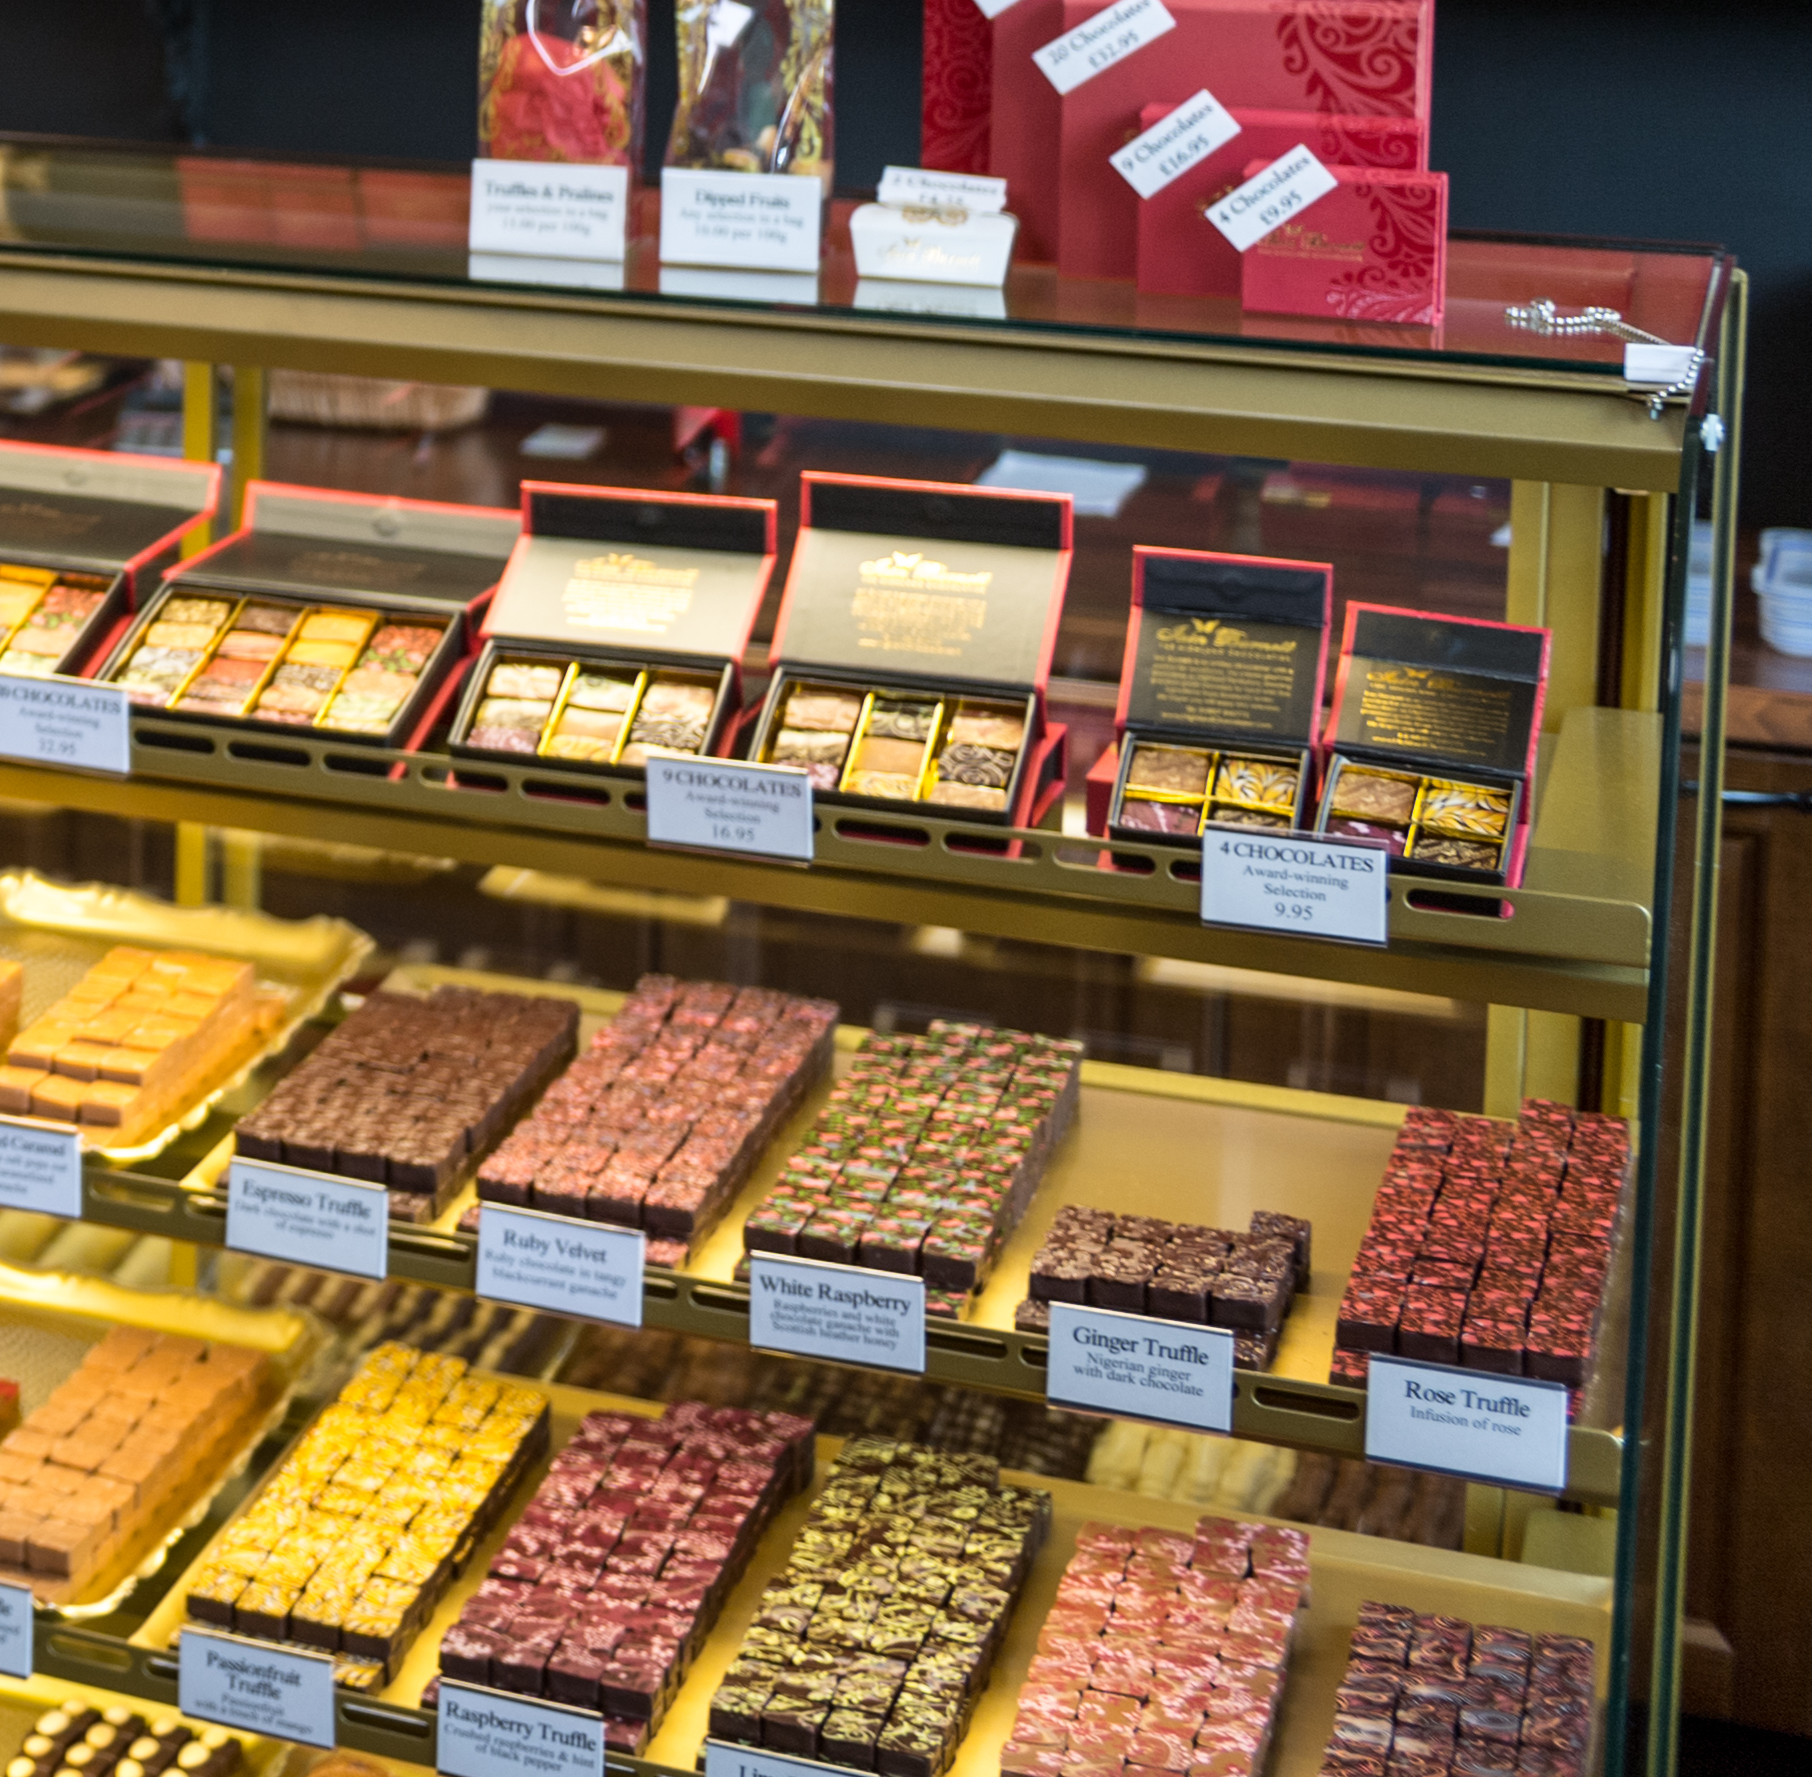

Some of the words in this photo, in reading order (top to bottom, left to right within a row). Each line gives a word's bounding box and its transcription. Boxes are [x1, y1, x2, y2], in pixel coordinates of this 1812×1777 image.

[1229, 156, 1312, 215] Chocolates
[12, 686, 122, 713] CHOCOLATES
[662, 768, 673, 782] 9
[675, 770, 802, 798] CHOCOLATES
[685, 791, 780, 813] Award-winning
[704, 808, 762, 824] Selection
[713, 824, 756, 842] 16.95
[1220, 841, 1230, 855] 4
[1233, 842, 1374, 873] CHOCOLATES
[1243, 865, 1349, 890] Award-winning
[1263, 883, 1326, 902] Selection
[1274, 901, 1313, 920] 9.95
[242, 1178, 312, 1206] Espresso
[315, 1192, 372, 1219] Truffle
[504, 1228, 550, 1256] Ruby
[555, 1237, 607, 1263] Velvet
[760, 1275, 813, 1297] White
[818, 1283, 911, 1316] Raspberry
[770, 1312, 823, 1326] chocolate
[826, 1322, 872, 1335] ganache
[875, 1325, 899, 1337] with
[773, 1299, 838, 1317] Raspberries
[842, 1310, 861, 1321] and
[865, 1313, 896, 1327] white
[773, 1321, 816, 1336] Scottish
[820, 1328, 860, 1342] heather
[863, 1334, 896, 1352] honey
[1073, 1326, 1139, 1354] Ginger
[1143, 1337, 1209, 1365] Truffle
[1073, 1364, 1103, 1379] with
[1106, 1370, 1136, 1385] dark
[1139, 1376, 1204, 1397] chocolate
[1087, 1352, 1145, 1373] Nigerian
[1148, 1364, 1192, 1382] ginger
[1404, 1380, 1456, 1406] Rose
[1460, 1389, 1531, 1418] Truffle
[1410, 1405, 1469, 1428] Infusion
[1472, 1414, 1488, 1429] of
[1491, 1423, 1522, 1436] rose
[207, 1649, 301, 1686] Passionfruit
[229, 1674, 281, 1700] Truffle
[446, 1700, 534, 1740] Raspberry
[537, 1722, 597, 1752] Truffle
[444, 1723, 491, 1744] Crushed
[494, 1735, 555, 1759] raspberries
[557, 1749, 569, 1763] &
[572, 1754, 595, 1769] hint
[475, 1744, 487, 1754] of
[491, 1745, 520, 1761] black
[523, 1754, 562, 1772] pepper
